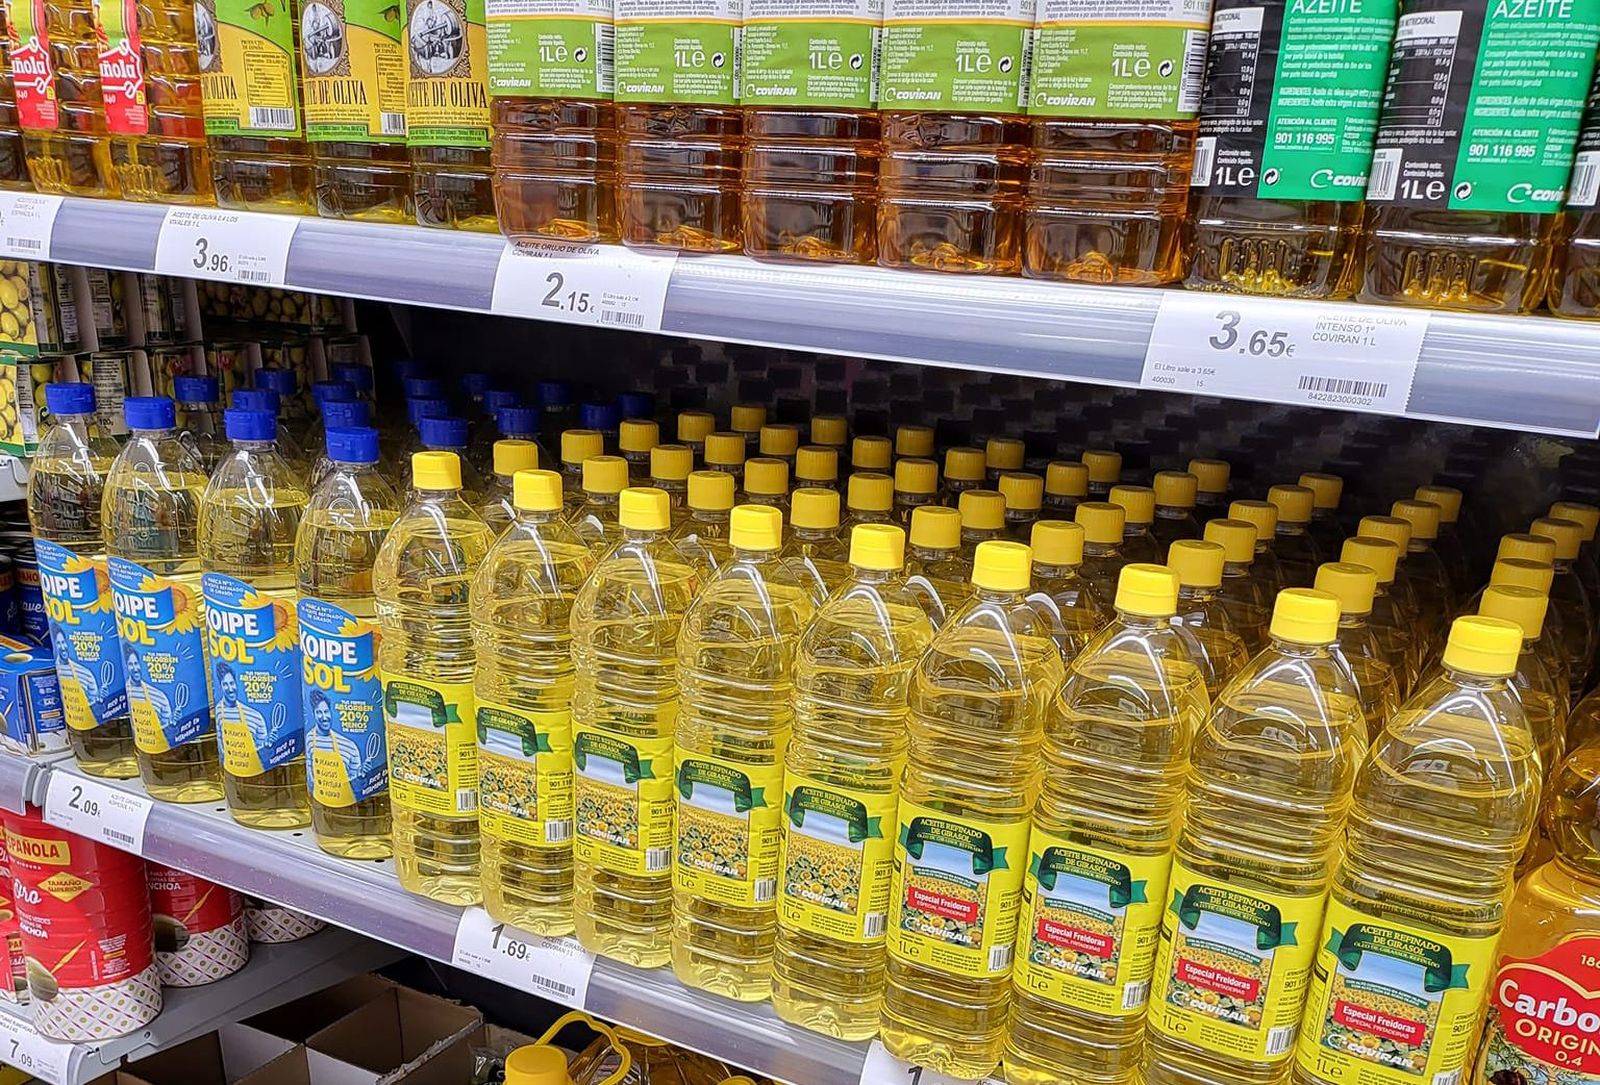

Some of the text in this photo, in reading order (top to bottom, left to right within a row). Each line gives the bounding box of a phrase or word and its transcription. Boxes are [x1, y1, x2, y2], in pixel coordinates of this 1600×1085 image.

[1291, 0, 1362, 14] AZEITE
[1492, 0, 1574, 19] AZEITE
[319, 80, 331, 105] DE
[333, 80, 368, 105] OLIVA
[432, 82, 447, 108] DE
[450, 82, 488, 109] OLIVA
[1275, 132, 1335, 145] 901 116 995
[1469, 144, 1537, 158] 901 116 995
[515, 241, 600, 256] ACEITE ORUJO DE OLIVA
[1315, 322, 1363, 335] INTENSO
[1375, 317, 1408, 327] OLIVA
[1208, 310, 1296, 358] 3.65€
[1312, 332, 1361, 346] COVIRAN
[1369, 337, 1377, 347] L
[1177, 366, 1190, 374] sale
[1151, 376, 1176, 385] 400030
[1307, 392, 1373, 407] 8422823000302
[41, 571, 84, 598] OIPE
[74, 640, 101, 651] 20%
[208, 629, 255, 665] SOL
[147, 662, 176, 673] 20%
[303, 654, 351, 693] SOL
[244, 681, 274, 693] 20%
[339, 710, 370, 725] 20%
[801, 787, 858, 807] ACEITE REFINADO
[811, 796, 820, 804] DE
[920, 818, 983, 839] ACEITE REFINADO
[931, 827, 972, 843] DE GIRASOL
[1053, 848, 1121, 872] ACEITE REFINADO
[1065, 857, 1109, 875] DE GIRASOL
[914, 890, 971, 913] Especial Freidoras
[1198, 886, 1271, 912] ACEITE REFINADO
[1210, 896, 1257, 916] DE GIRASOL
[1044, 922, 1106, 948] Especial Freidoras
[1360, 925, 1441, 953] ACEITE REFINADO
[1373, 936, 1426, 957] DE GIRASOL
[1184, 962, 1251, 991] Especial Freidoras
[1342, 1005, 1416, 1034] Especial Freidoras
[1345, 1016, 1410, 1040] ESPECIAL FRITADEIRAS
[1555, 1050, 1582, 1067] 0,4
